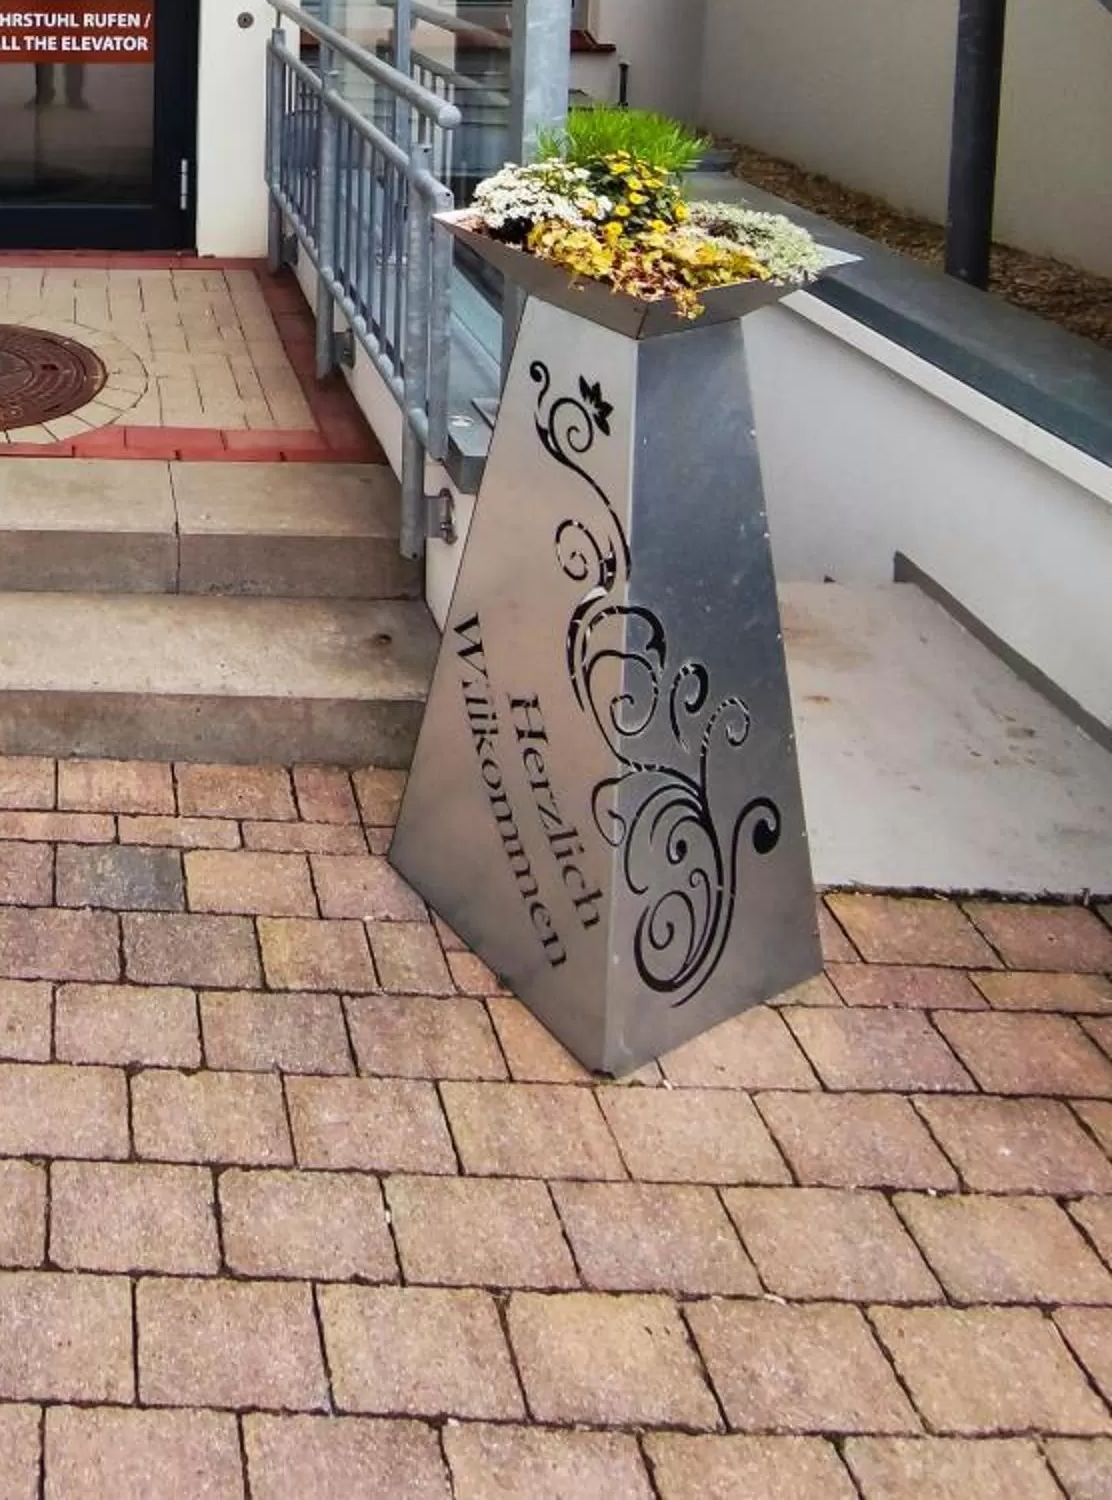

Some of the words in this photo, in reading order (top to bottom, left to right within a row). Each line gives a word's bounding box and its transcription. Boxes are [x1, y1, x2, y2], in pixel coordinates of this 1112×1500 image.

[83, 12, 141, 28] RUFEN
[23, 35, 58, 51] THE
[61, 35, 149, 51] ELEVATOR
[507, 692, 605, 930] Herzlich
